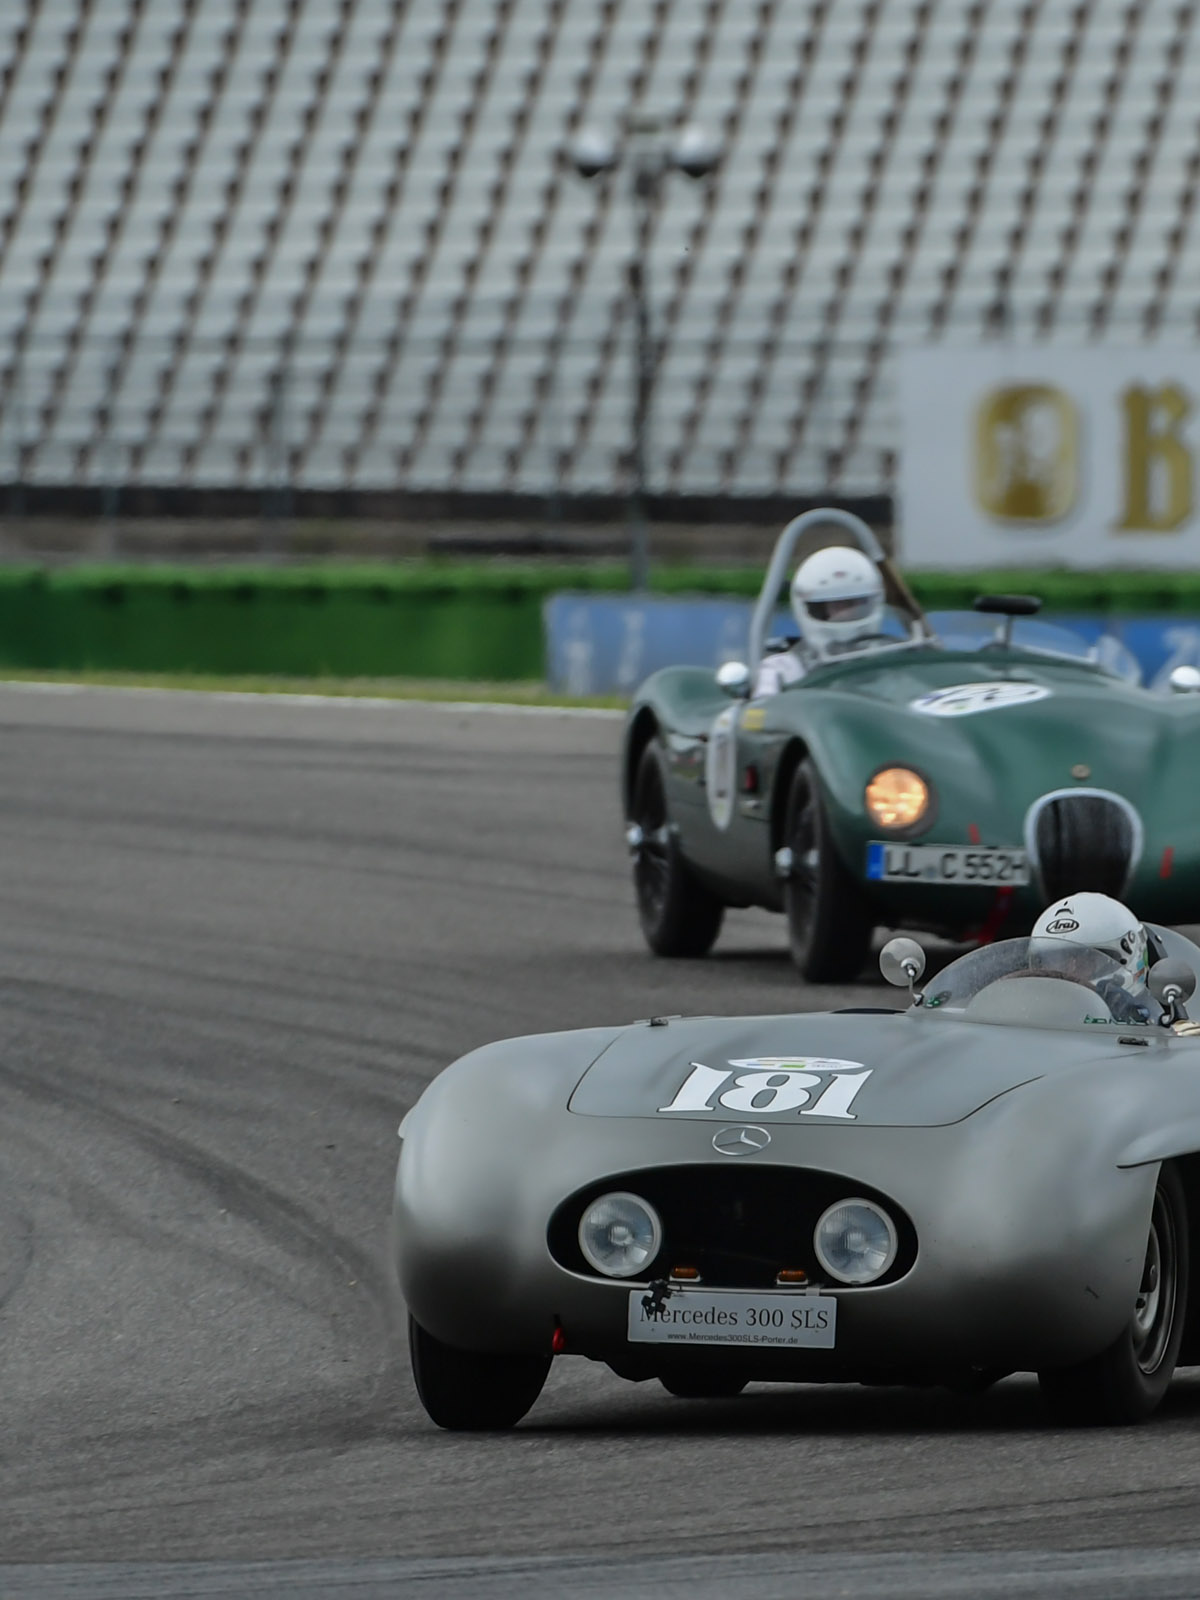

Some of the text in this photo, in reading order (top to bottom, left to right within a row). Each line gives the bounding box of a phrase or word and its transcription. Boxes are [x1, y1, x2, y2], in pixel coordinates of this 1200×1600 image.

[886, 851, 921, 877] LL
[940, 853, 958, 878] C
[656, 1062, 874, 1120] 181
[640, 1307, 828, 1329] Mercedes 300 SLS
[667, 1332, 798, 1345] www.Mercedes300SLS-Porter.de
